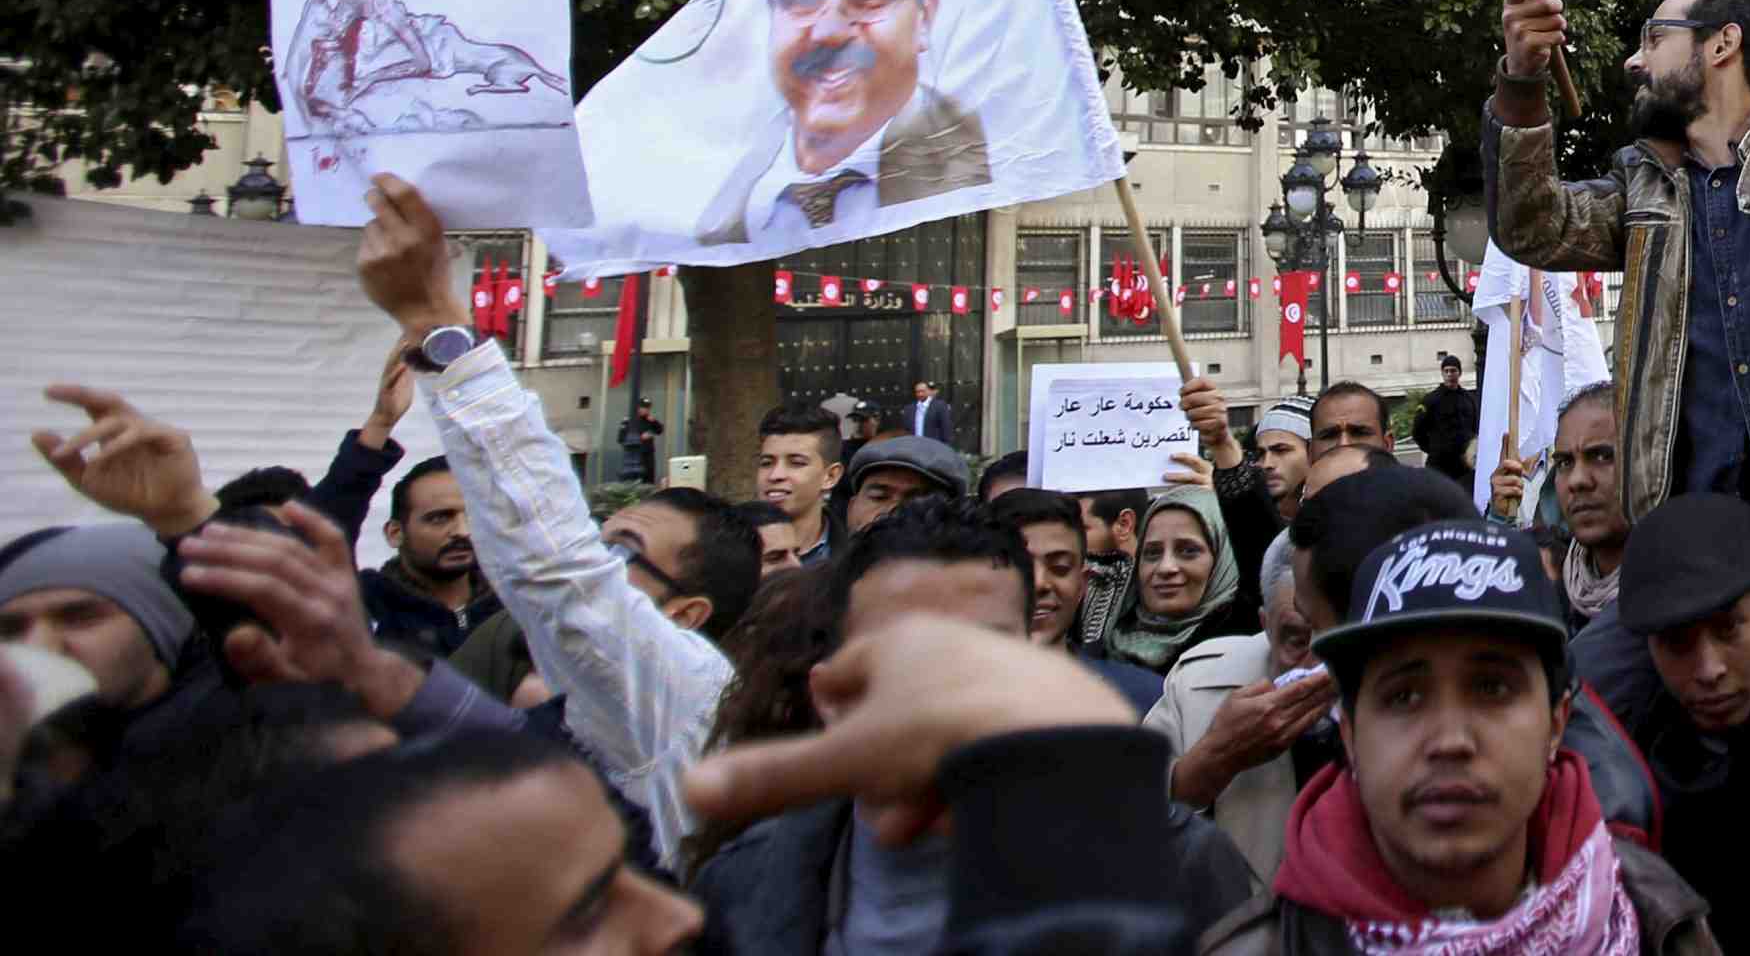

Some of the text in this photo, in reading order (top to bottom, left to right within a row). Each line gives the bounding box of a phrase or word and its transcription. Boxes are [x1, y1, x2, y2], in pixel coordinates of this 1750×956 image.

[1054, 392, 1173, 418] حكومة عار عار
[1054, 431, 1076, 453] نار
[1081, 428, 1126, 446] شعلت
[1400, 528, 1507, 552] LOS ANGELES
[1361, 545, 1524, 624] Kings
